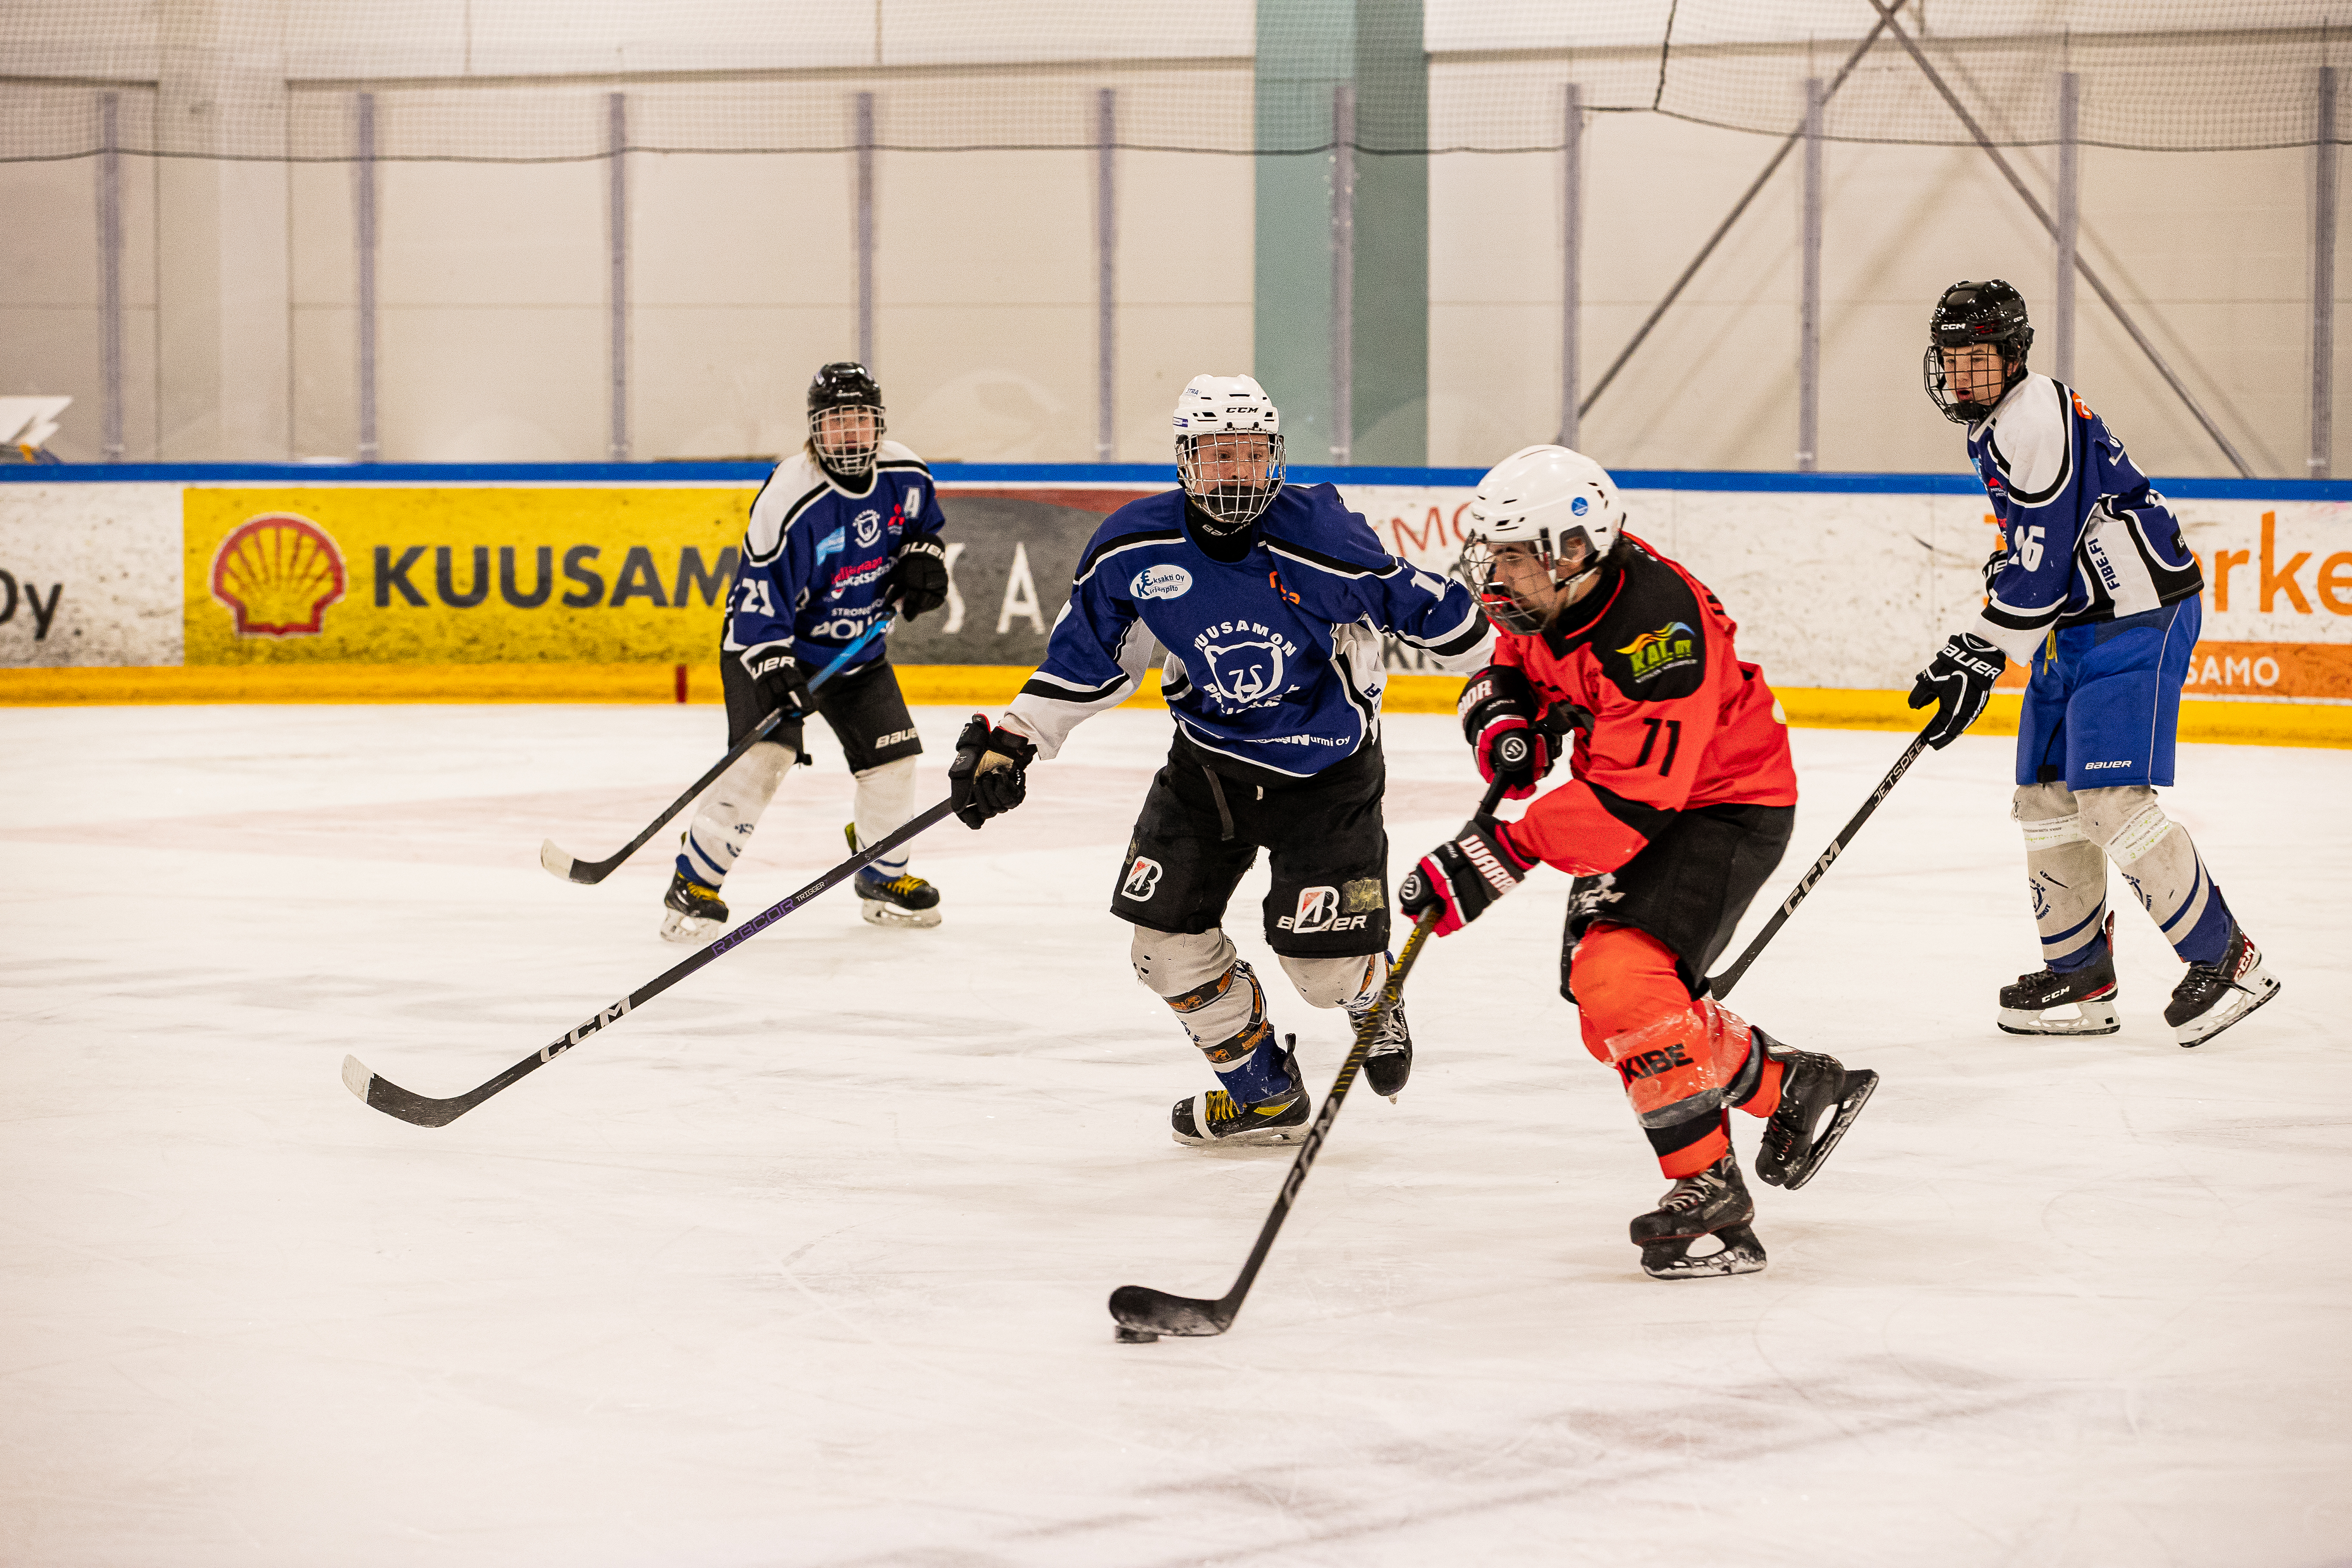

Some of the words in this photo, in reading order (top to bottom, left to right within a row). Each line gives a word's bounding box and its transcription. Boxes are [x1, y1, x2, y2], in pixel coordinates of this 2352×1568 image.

[2088, 538, 2120, 590] FIBE.FI
[741, 578, 775, 617] 21
[1943, 643, 2001, 679] AUER
[1874, 736, 1926, 807] JETSPEE
[2085, 760, 2132, 770] BAUER
[1784, 840, 1842, 916] CCM
[712, 898, 796, 957] RIBCOR
[796, 882, 825, 902] TRIGGER
[2042, 986, 2070, 1003] CCM
[541, 996, 632, 1063] CCM
[1618, 1043, 1694, 1083] KIBE
